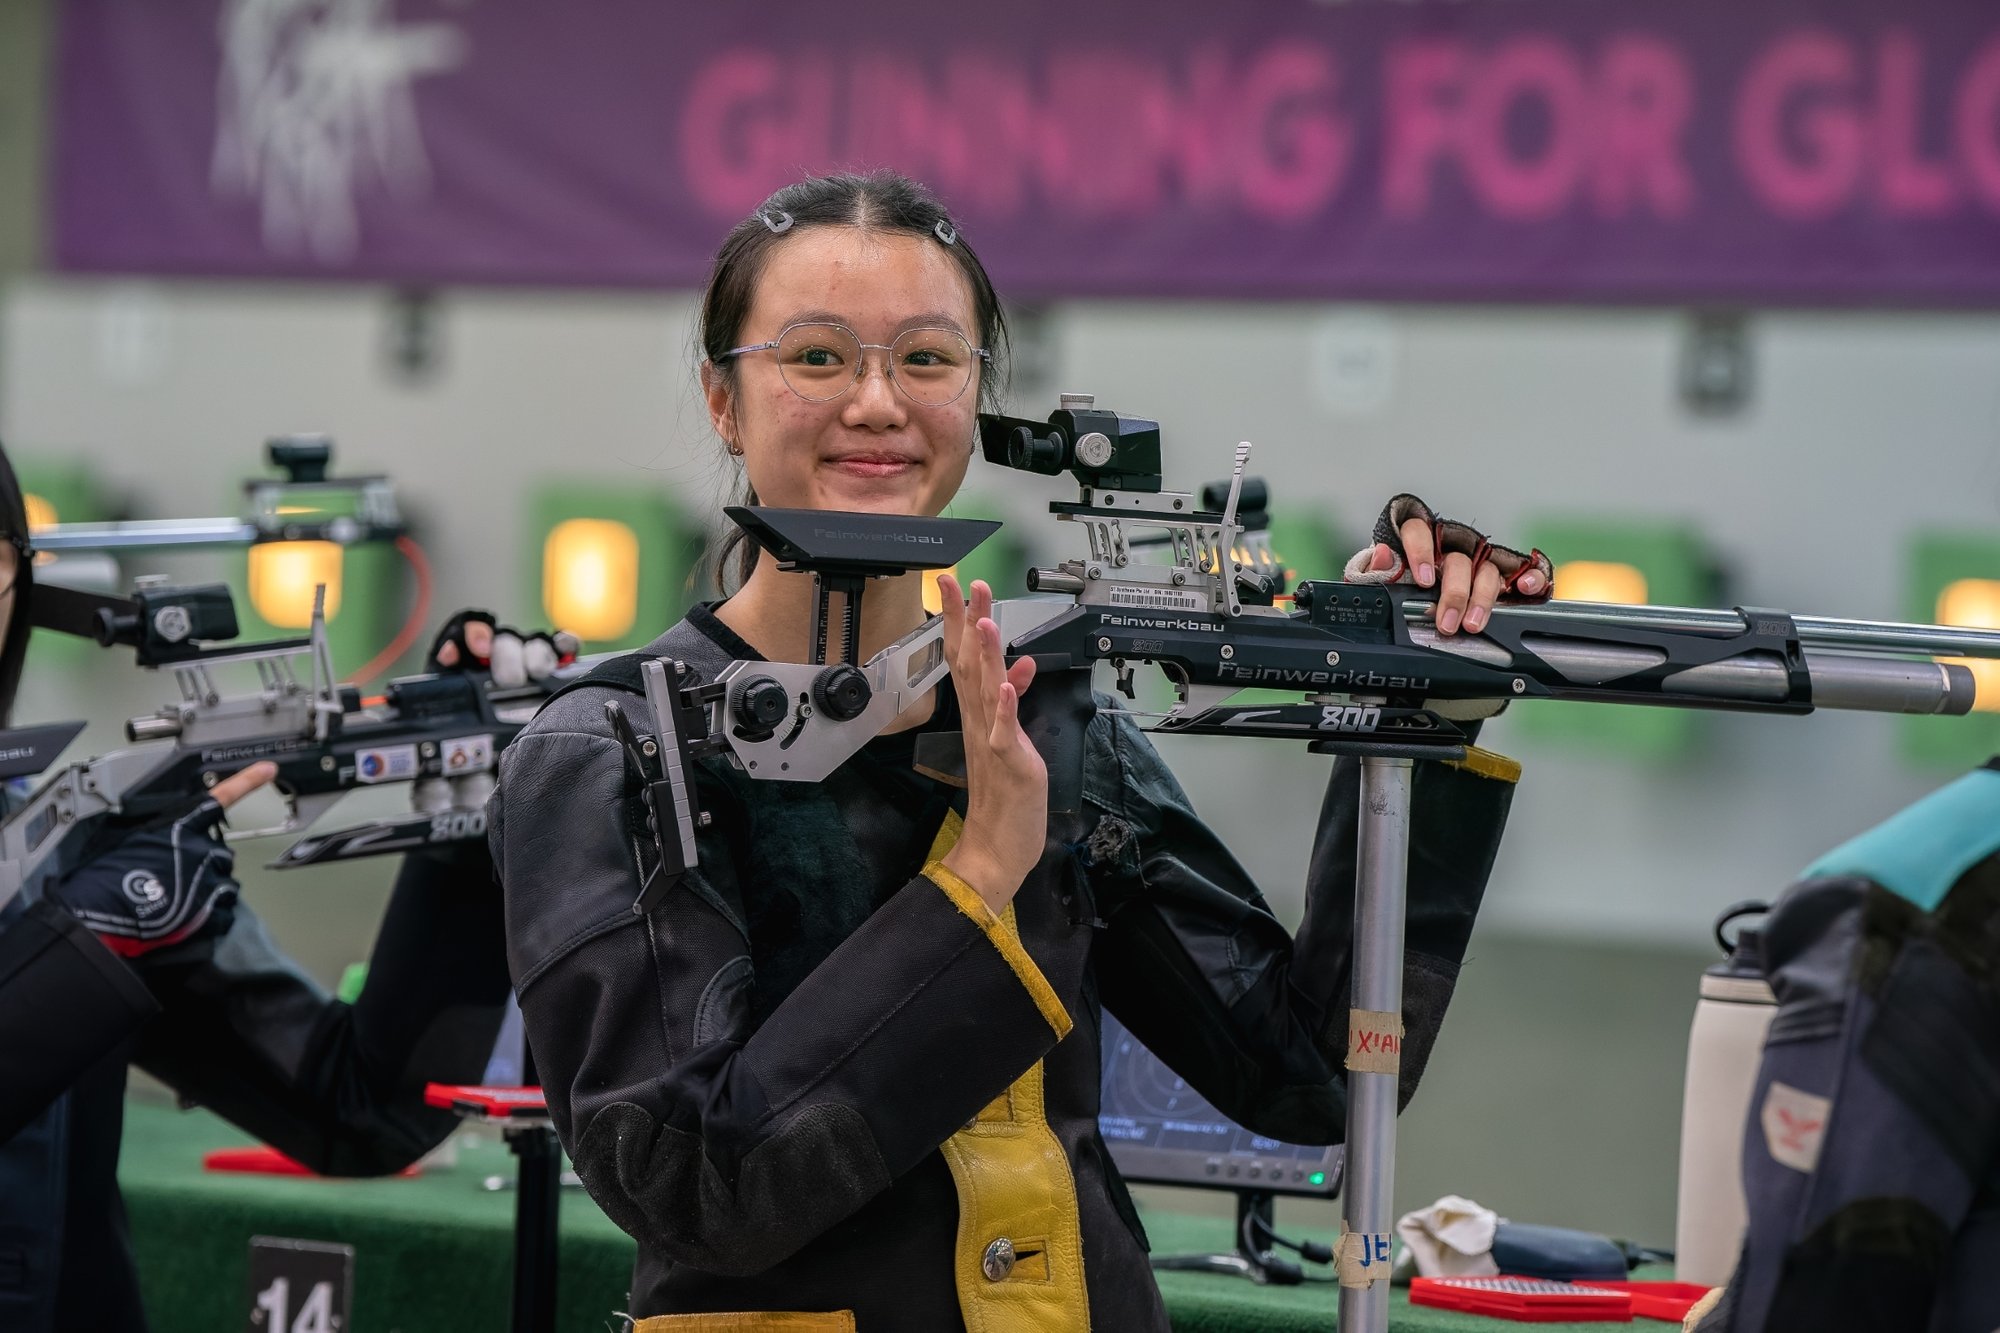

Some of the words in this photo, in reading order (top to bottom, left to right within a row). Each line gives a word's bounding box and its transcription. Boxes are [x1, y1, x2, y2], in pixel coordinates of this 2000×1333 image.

[680, 44, 1354, 217] GUNNING
[1382, 38, 1696, 217] FOR
[813, 527, 944, 545] Feinwerkbau
[1100, 613, 1225, 632] Feinwerkbau
[1756, 620, 1791, 637] 800
[1130, 639, 1164, 654] 800
[1216, 660, 1431, 690] Feinwerkbau
[1317, 705, 1382, 733] 800
[429, 812, 488, 843] 800
[1359, 1233, 1393, 1268] JE
[257, 1276, 337, 1333] 14
